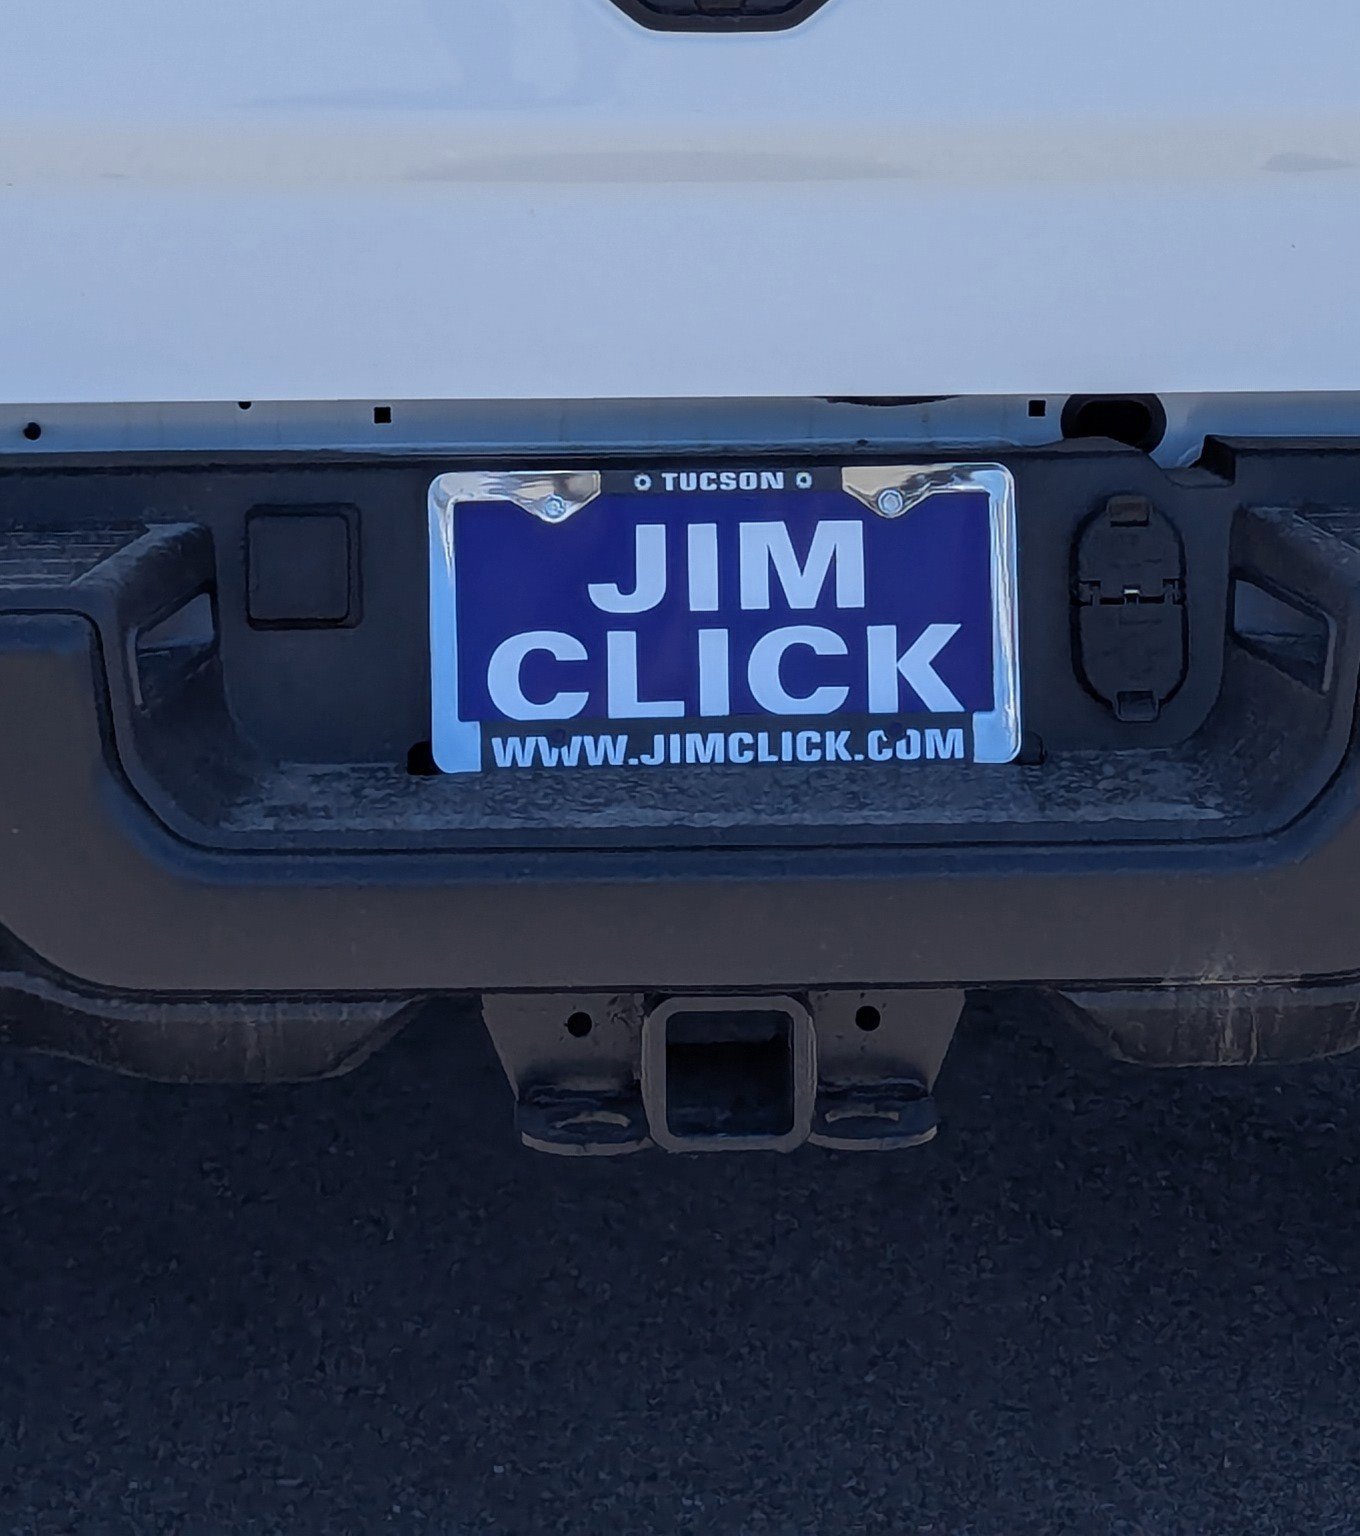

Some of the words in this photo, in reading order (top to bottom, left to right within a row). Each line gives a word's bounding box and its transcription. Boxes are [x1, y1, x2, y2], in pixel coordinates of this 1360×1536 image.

[661, 471, 785, 492] TUCSON
[587, 520, 866, 613] JIM
[487, 623, 965, 721] CLICK
[491, 728, 965, 768] WWW.JIMCLICK.COM
